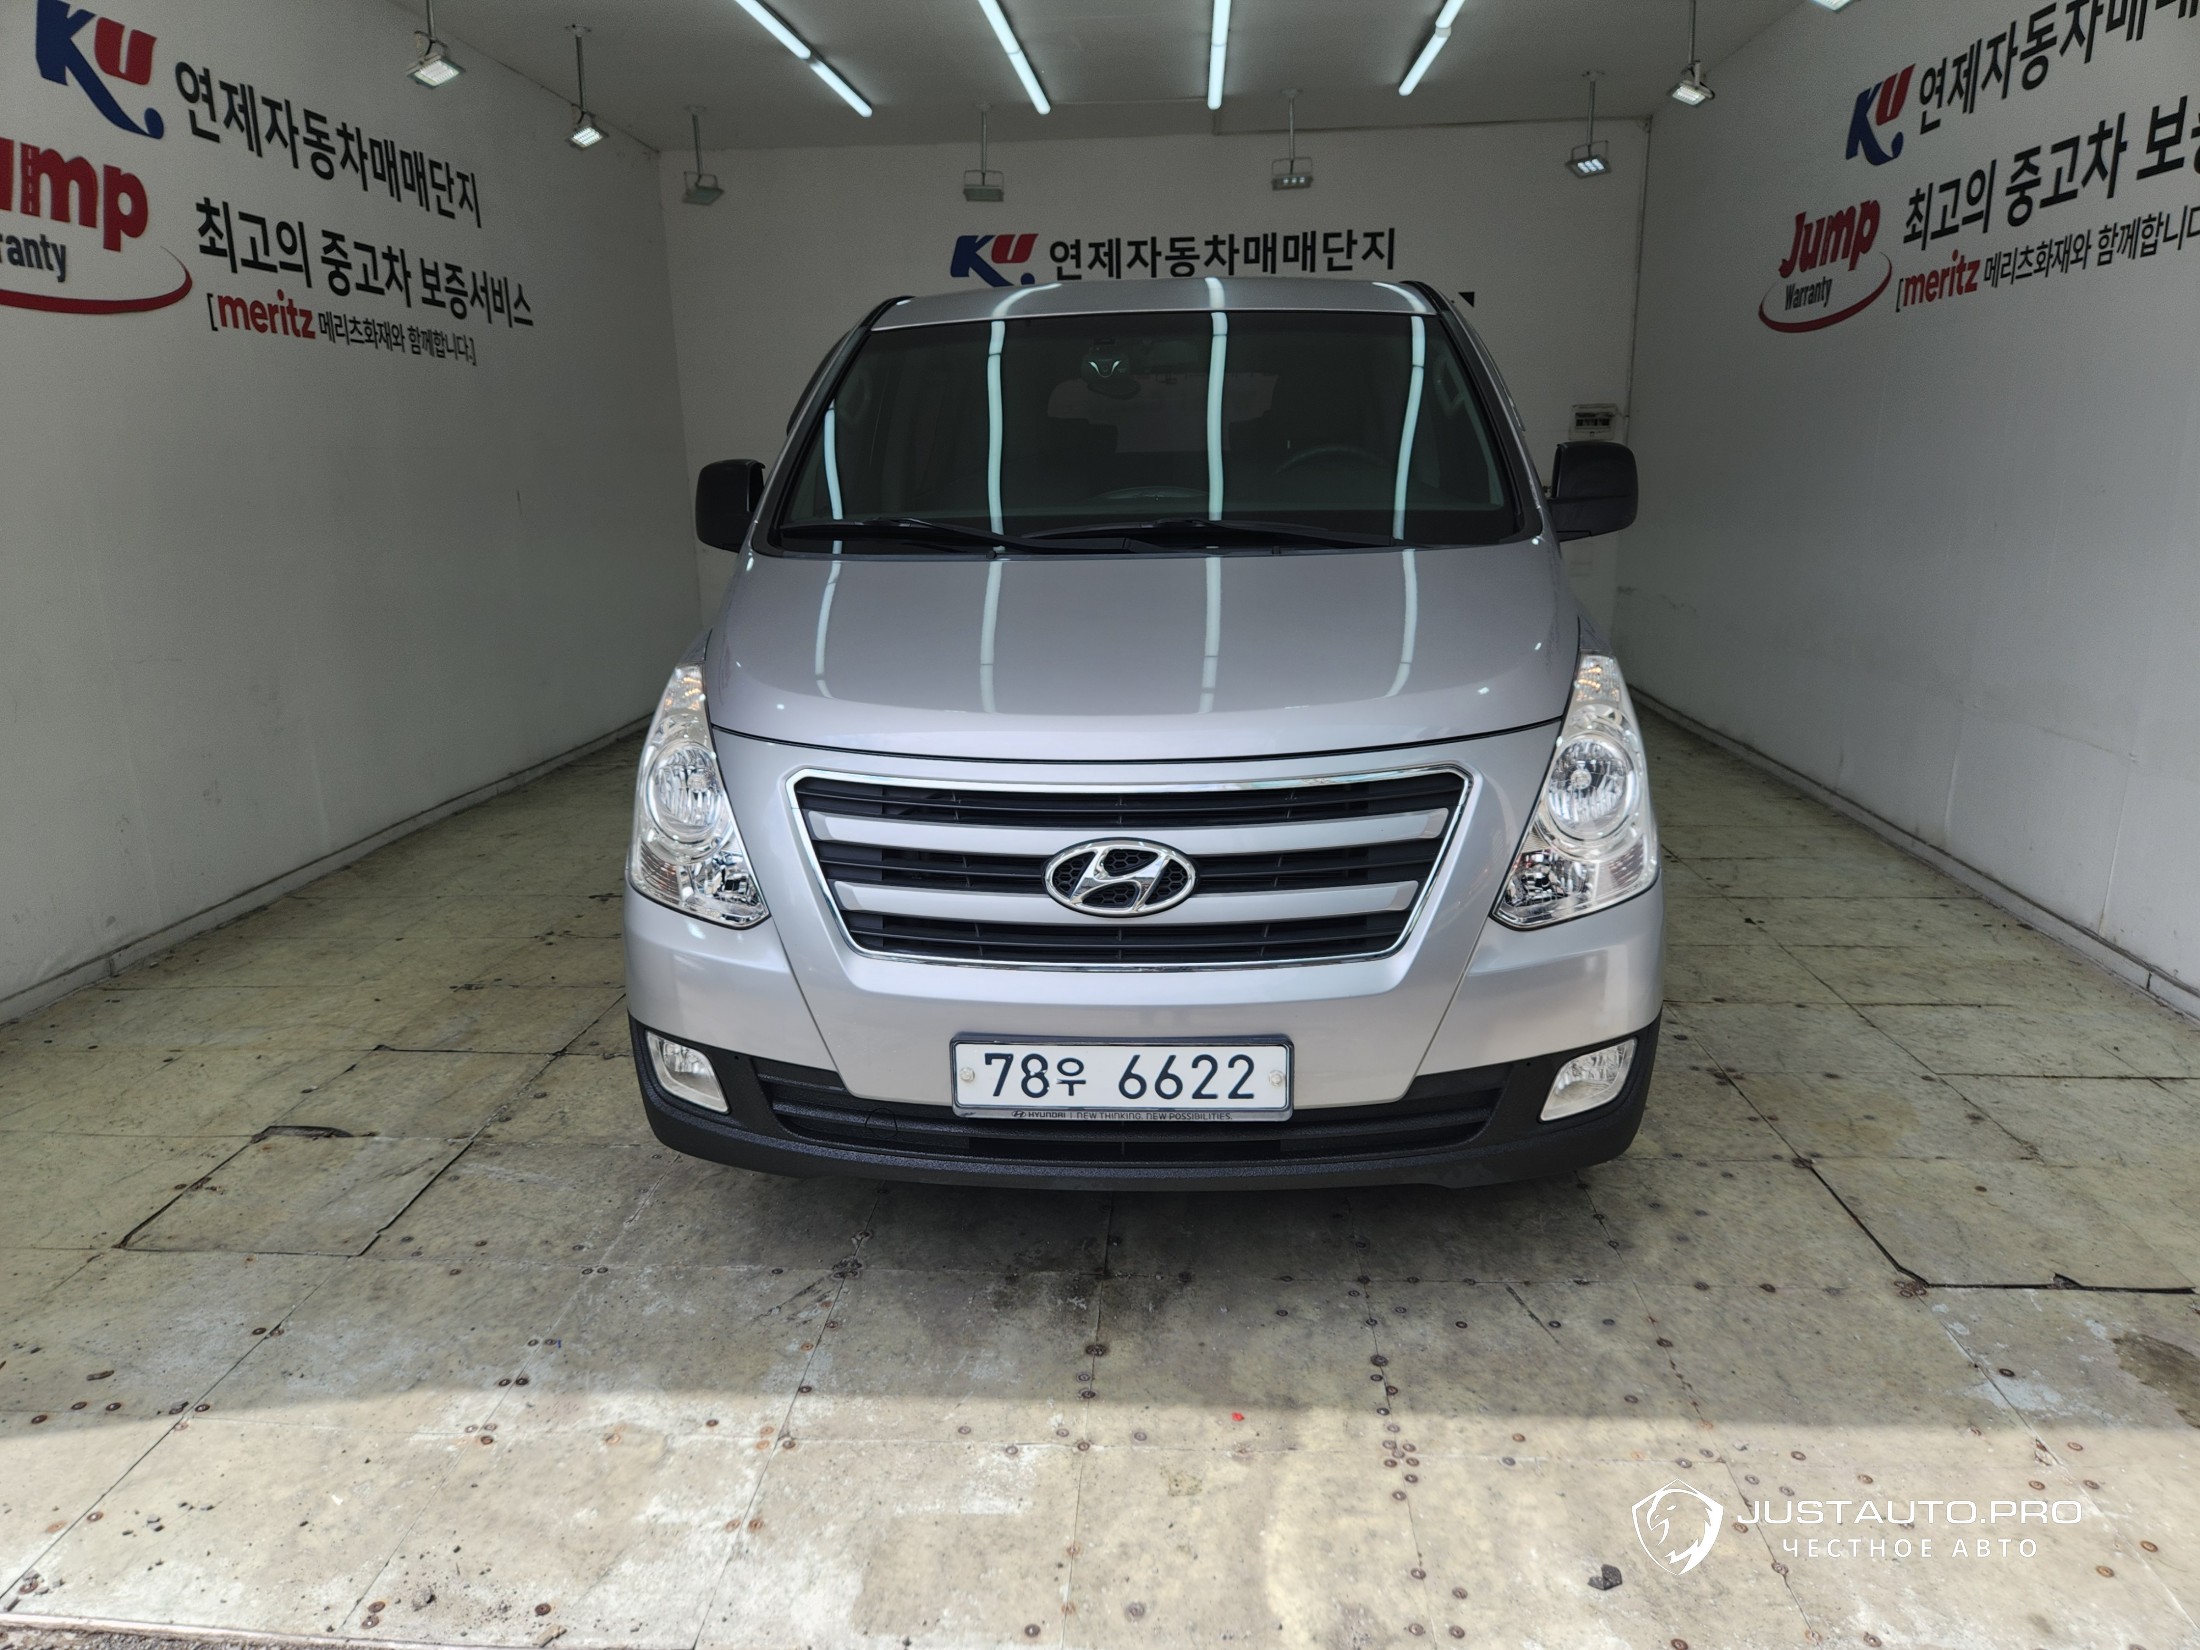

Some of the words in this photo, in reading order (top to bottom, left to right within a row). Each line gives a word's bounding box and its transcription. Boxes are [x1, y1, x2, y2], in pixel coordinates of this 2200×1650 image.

[1919, 0, 2199, 135] 연제자동차
[1846, 64, 1915, 165] KU
[175, 61, 482, 228] 연제자동차매매단지
[1903, 159, 1996, 251] 최고의
[2005, 112, 2128, 227] 중고차
[2136, 95, 2200, 181] 보
[0, 233, 66, 282] anty
[196, 197, 312, 288] 최고의
[320, 229, 411, 308] 중고차
[420, 257, 534, 327] 보증서비스
[1049, 228, 1396, 281] 연제자동차매매단지
[1778, 200, 1881, 279] Jump
[1983, 229, 2092, 288] 메리츠화재와
[1785, 276, 1832, 311] Warranty
[318, 312, 405, 353] 메리츠화재와
[984, 1052, 1087, 1099] 78우
[1118, 1054, 1255, 1101] 6622
[1028, 1111, 1066, 1119] HYUNDAI
[1077, 1111, 1097, 1120] NEW
[1146, 1111, 1167, 1121] NEW
